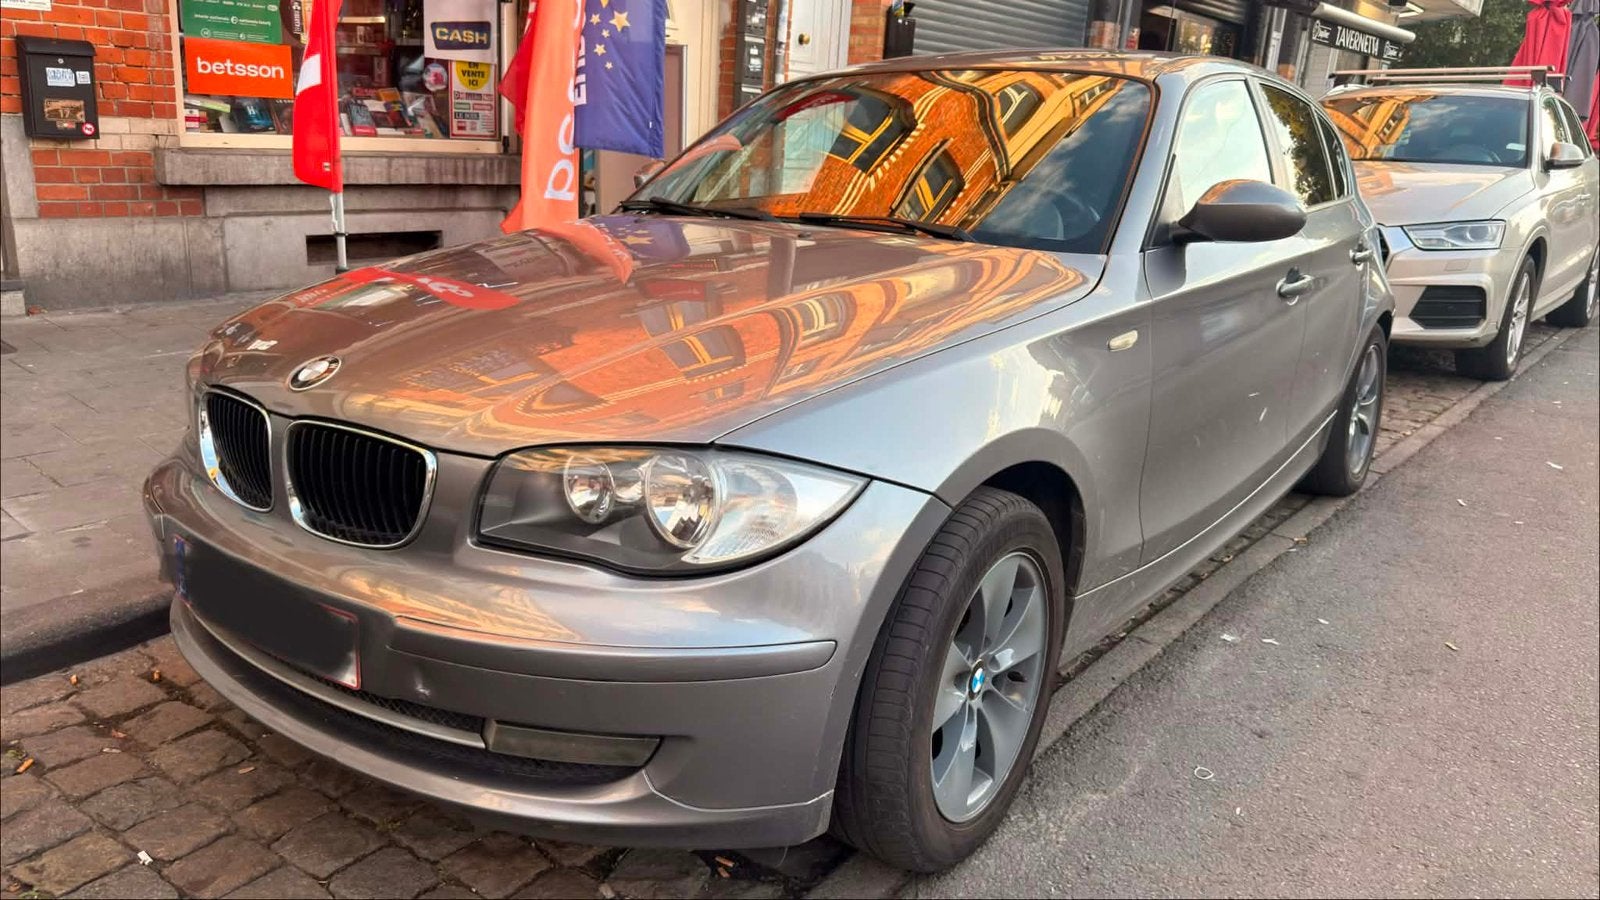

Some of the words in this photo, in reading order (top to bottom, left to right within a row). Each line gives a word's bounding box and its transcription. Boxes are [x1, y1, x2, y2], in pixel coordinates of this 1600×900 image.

[1335, 26, 1379, 56] TAVERNETTA
[196, 56, 284, 79] betsson
[468, 62, 480, 70] EN
[461, 69, 486, 79] VENTE
[468, 78, 479, 87] ICI
